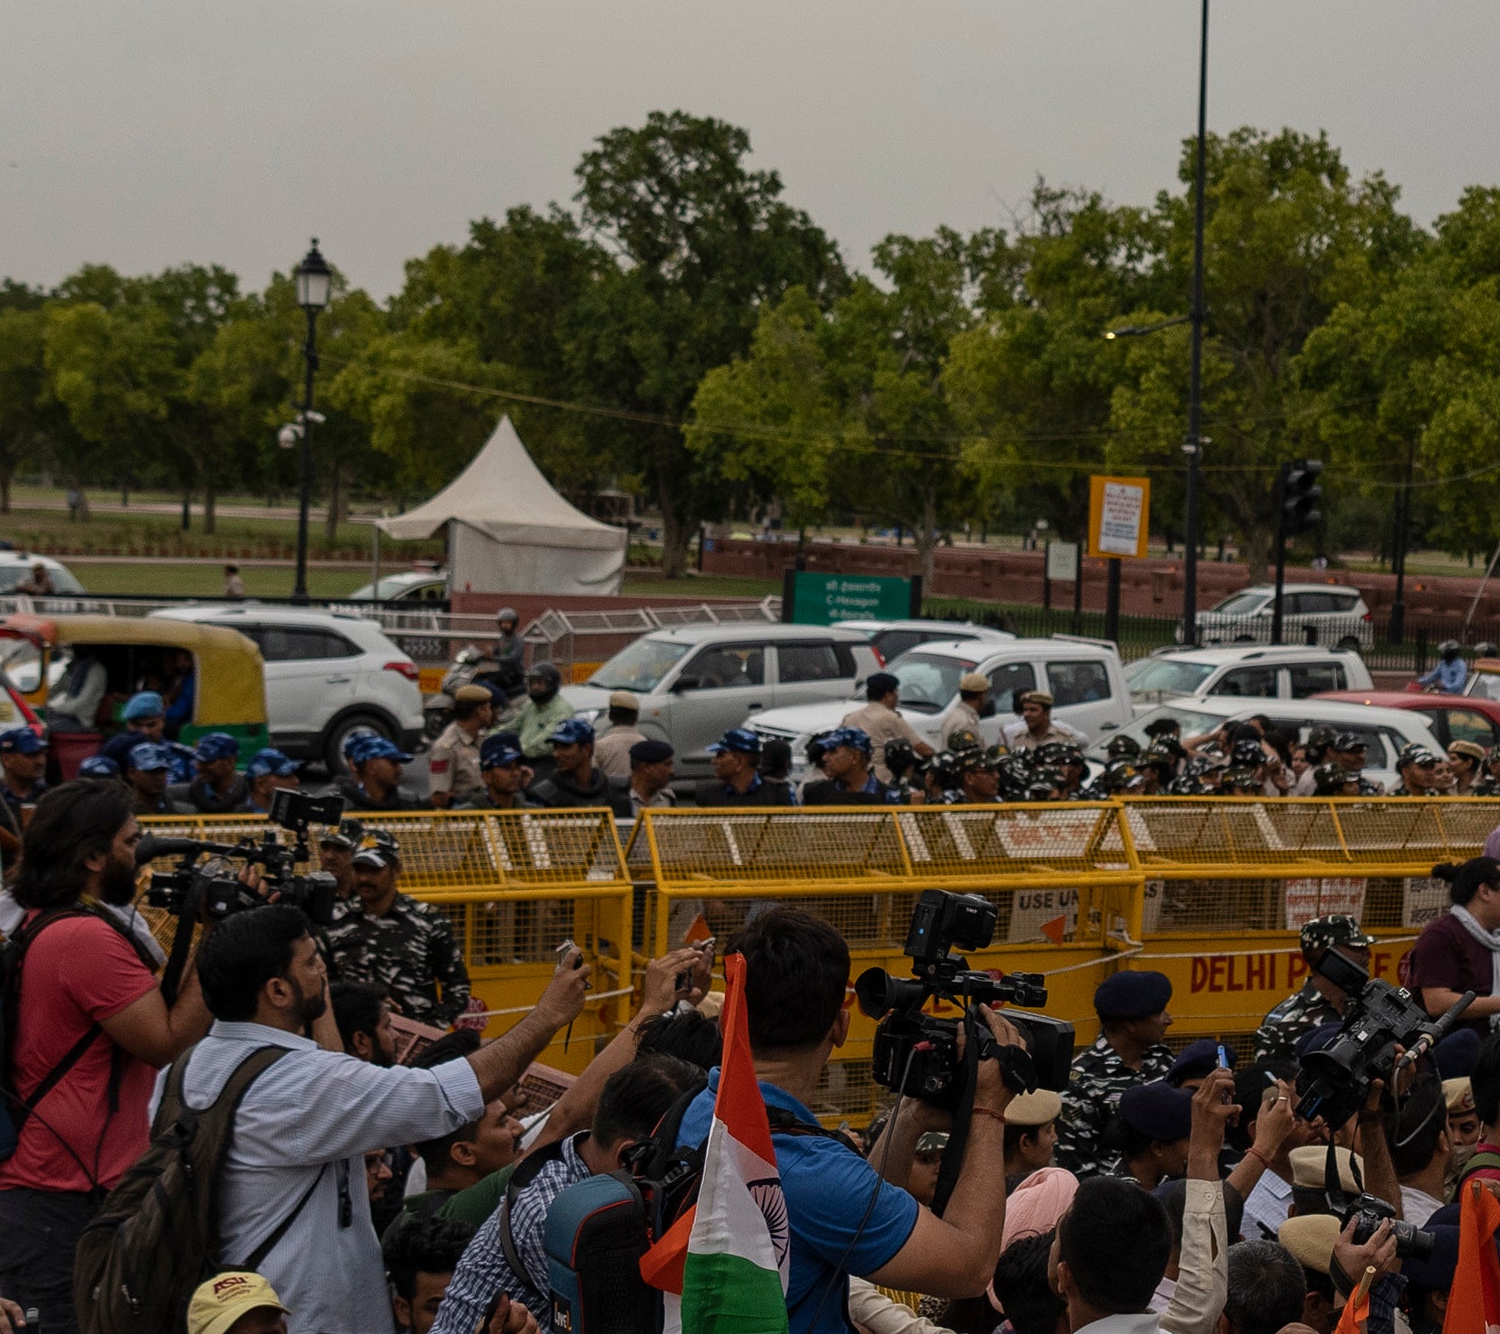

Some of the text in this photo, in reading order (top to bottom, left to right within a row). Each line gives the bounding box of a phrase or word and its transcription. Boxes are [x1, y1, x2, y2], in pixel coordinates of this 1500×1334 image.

[1019, 892, 1054, 909] USE
[1191, 954, 1275, 994] DELHI
[213, 1276, 247, 1294] ASU
